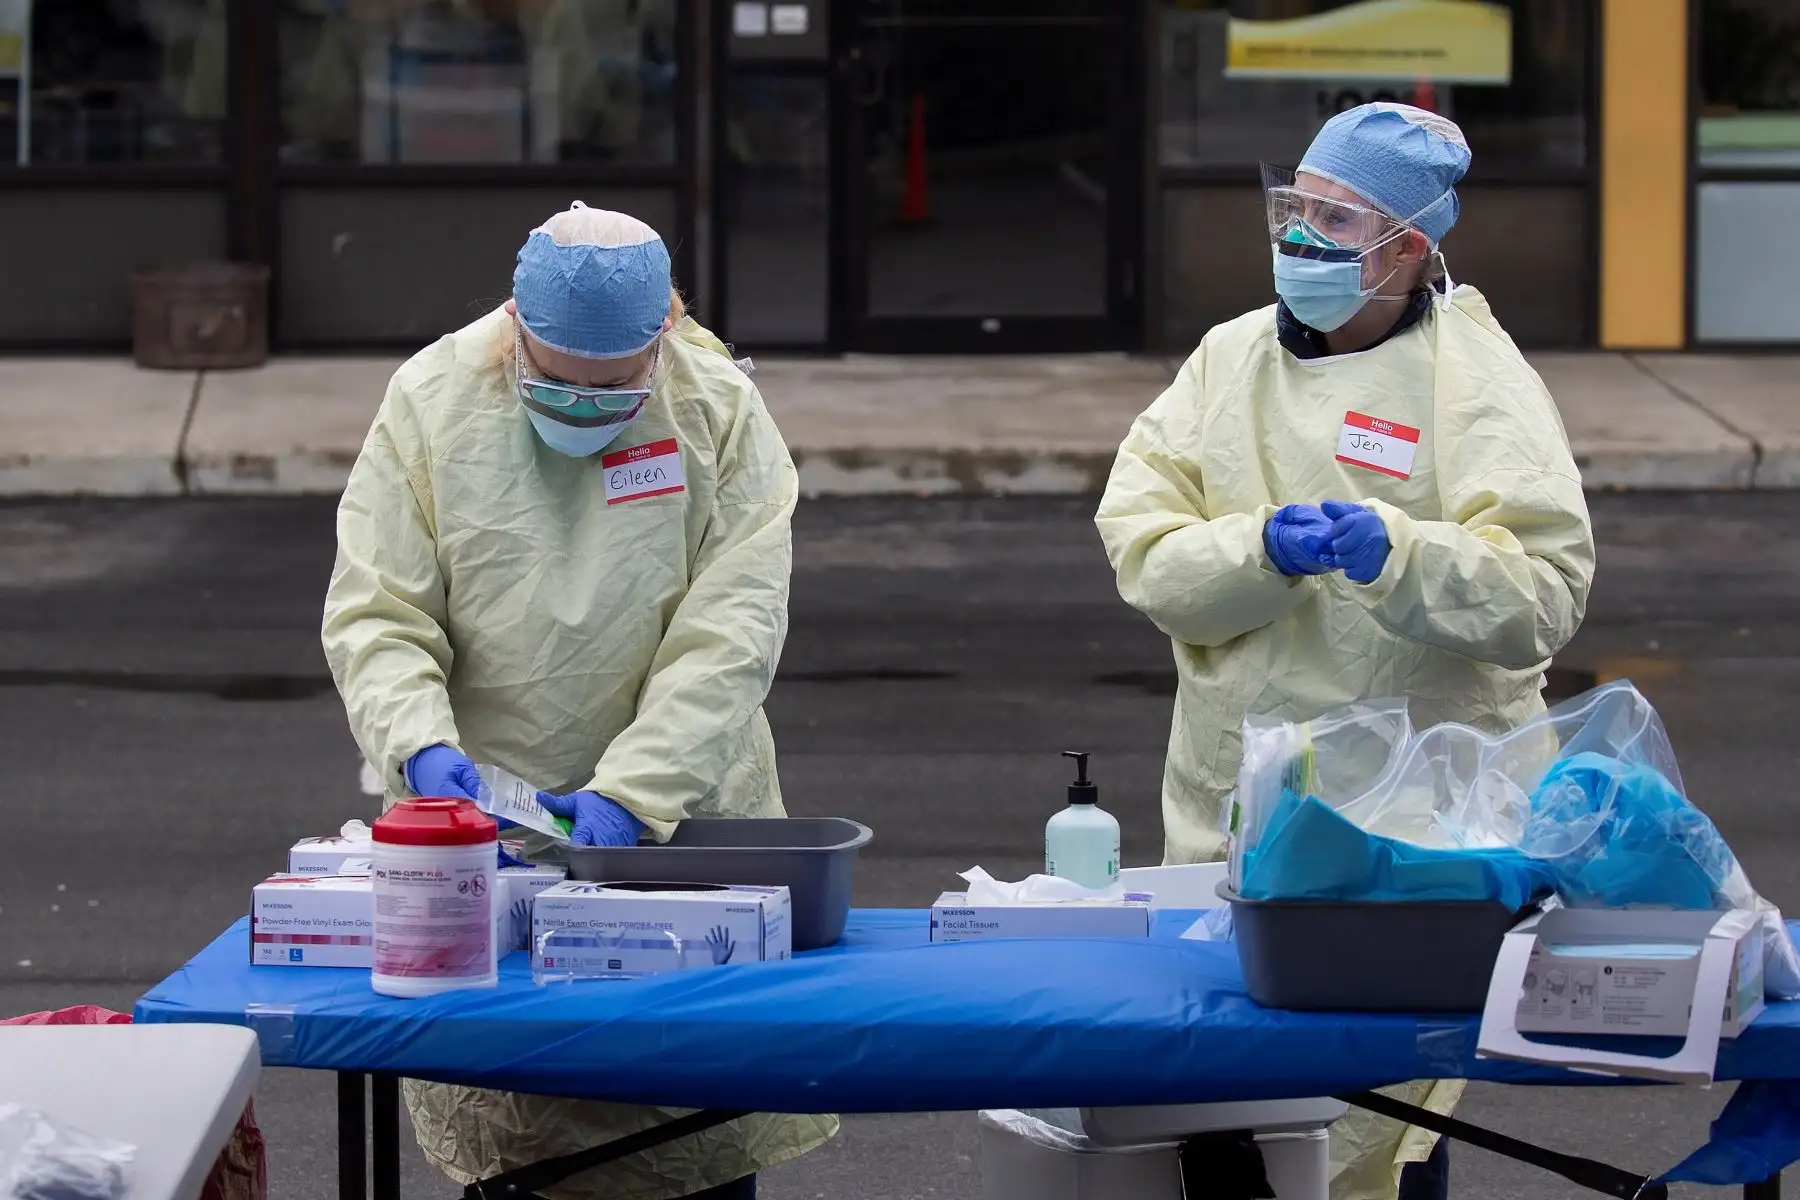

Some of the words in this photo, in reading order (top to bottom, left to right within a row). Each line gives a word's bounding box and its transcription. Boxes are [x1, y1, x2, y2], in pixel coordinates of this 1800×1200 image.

[1371, 419, 1393, 431] Hello
[1348, 433, 1383, 453] Jen
[628, 447, 650, 458] Hello
[610, 467, 667, 490] Eileen
[262, 917, 311, 926] Powder-Free
[312, 918, 331, 928] Vinyl
[333, 918, 354, 926] Exam
[543, 918, 565, 927] Nitrile
[566, 919, 588, 928] Exam
[589, 919, 618, 928] Gloves
[619, 921, 674, 930] POWDER-FREE
[943, 920, 967, 929] Facial
[969, 920, 999, 929] Tissues
